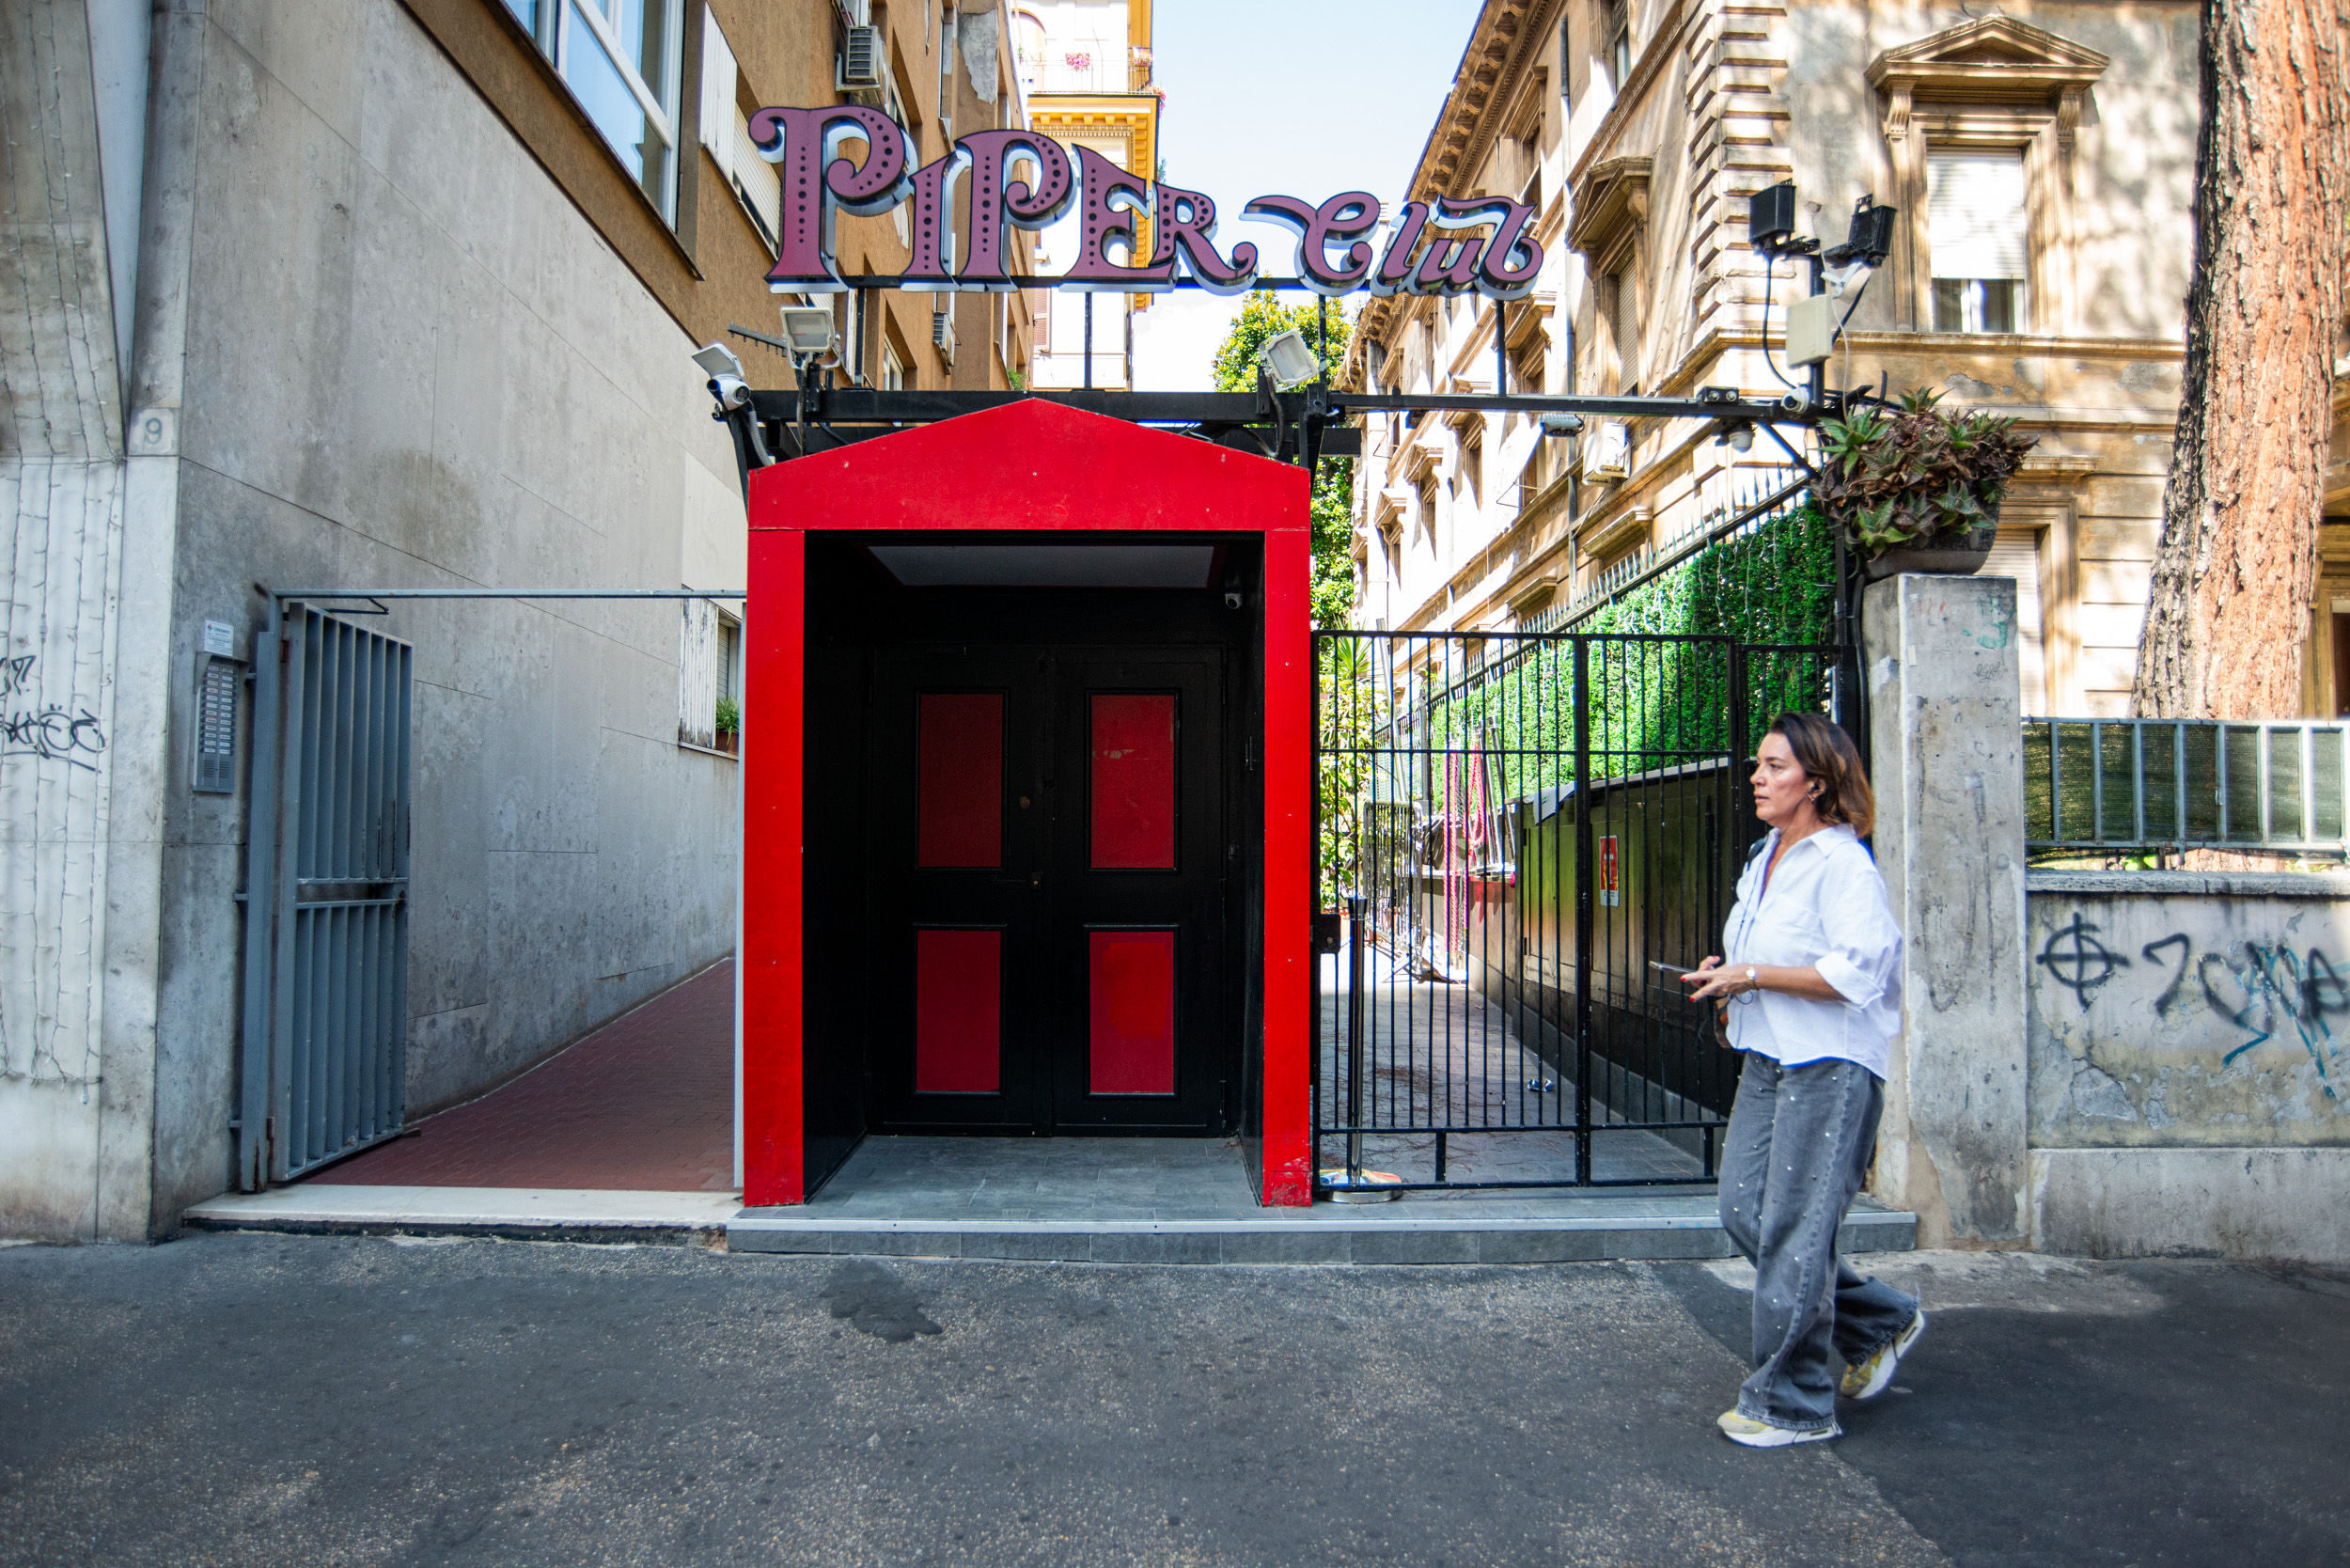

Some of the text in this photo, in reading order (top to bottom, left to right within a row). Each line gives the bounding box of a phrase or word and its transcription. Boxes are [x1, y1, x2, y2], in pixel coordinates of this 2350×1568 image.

[748, 105, 1544, 298] PIPER Club
[145, 417, 163, 445] 9
